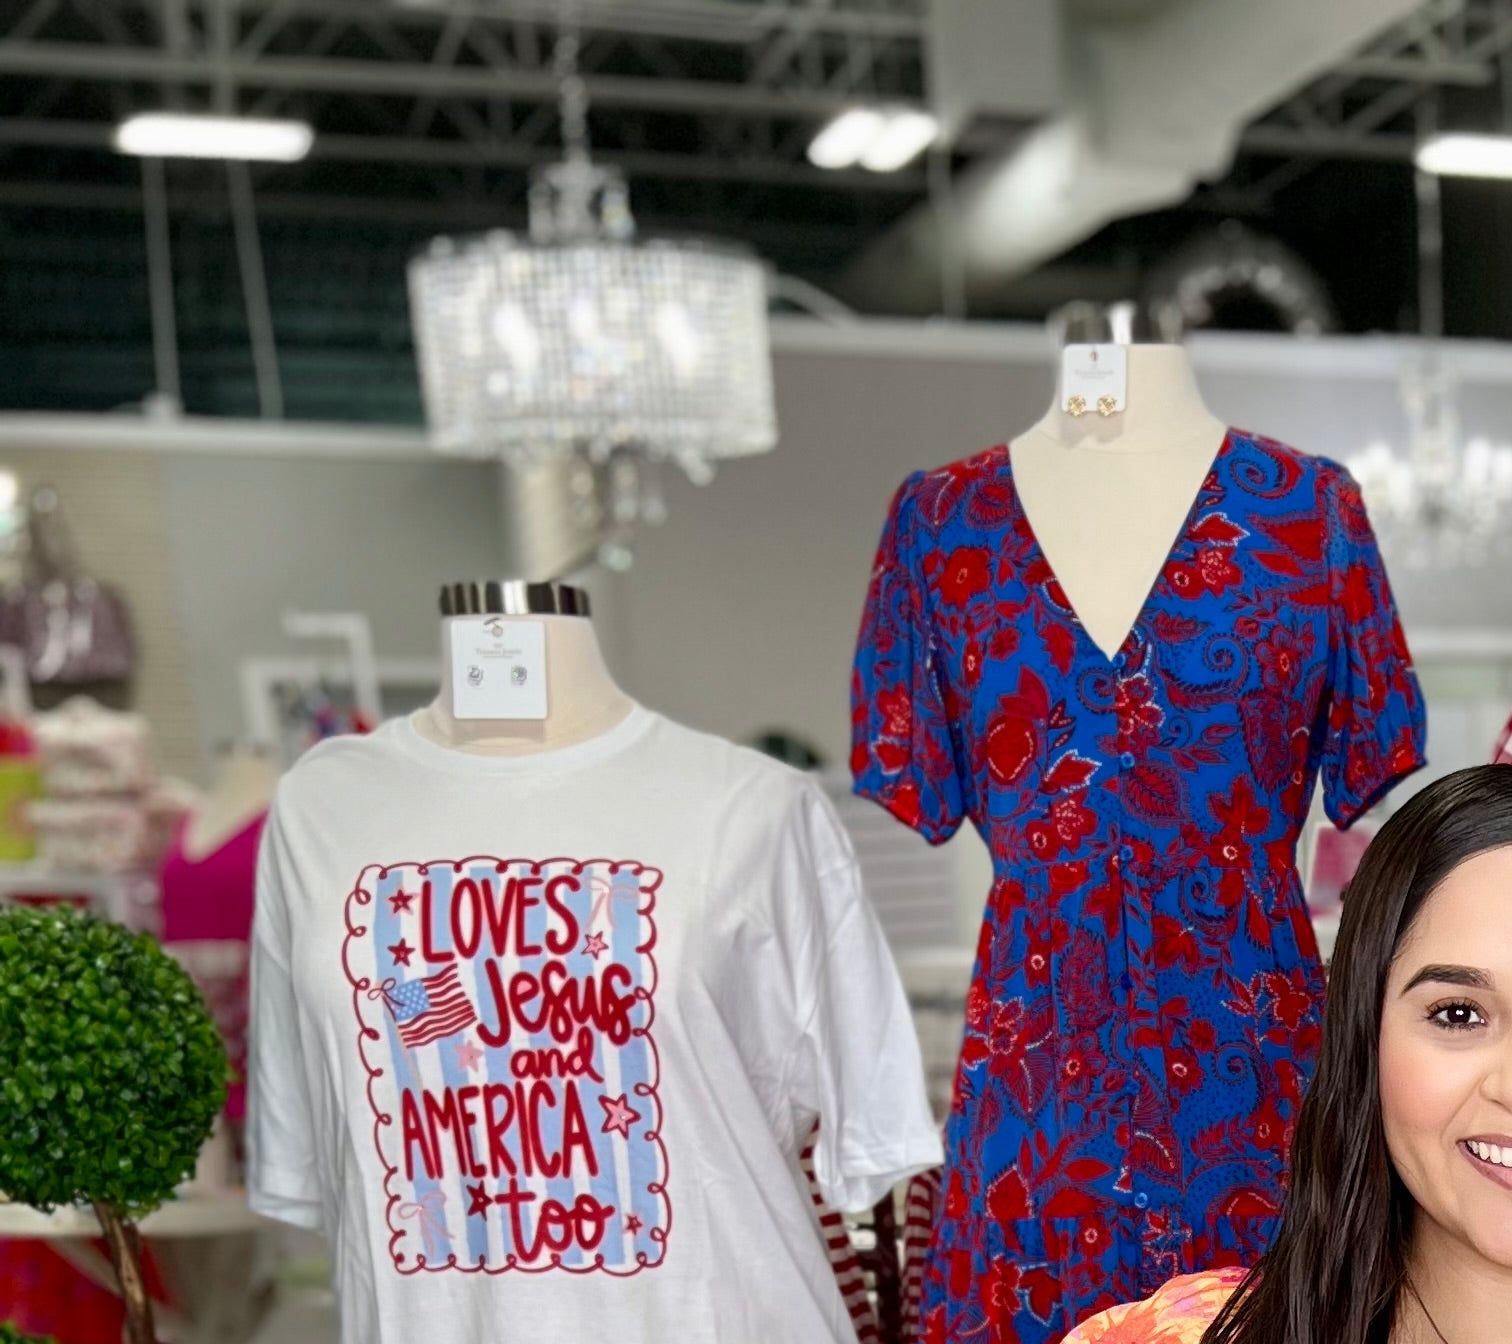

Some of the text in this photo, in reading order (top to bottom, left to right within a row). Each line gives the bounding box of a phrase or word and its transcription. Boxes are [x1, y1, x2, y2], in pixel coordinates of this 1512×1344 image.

[421, 876, 580, 963] LOVES
[477, 958, 637, 1048] Jesus
[510, 1028, 604, 1082] and
[401, 1080, 599, 1181] AMERICA
[495, 1178, 616, 1262] too
